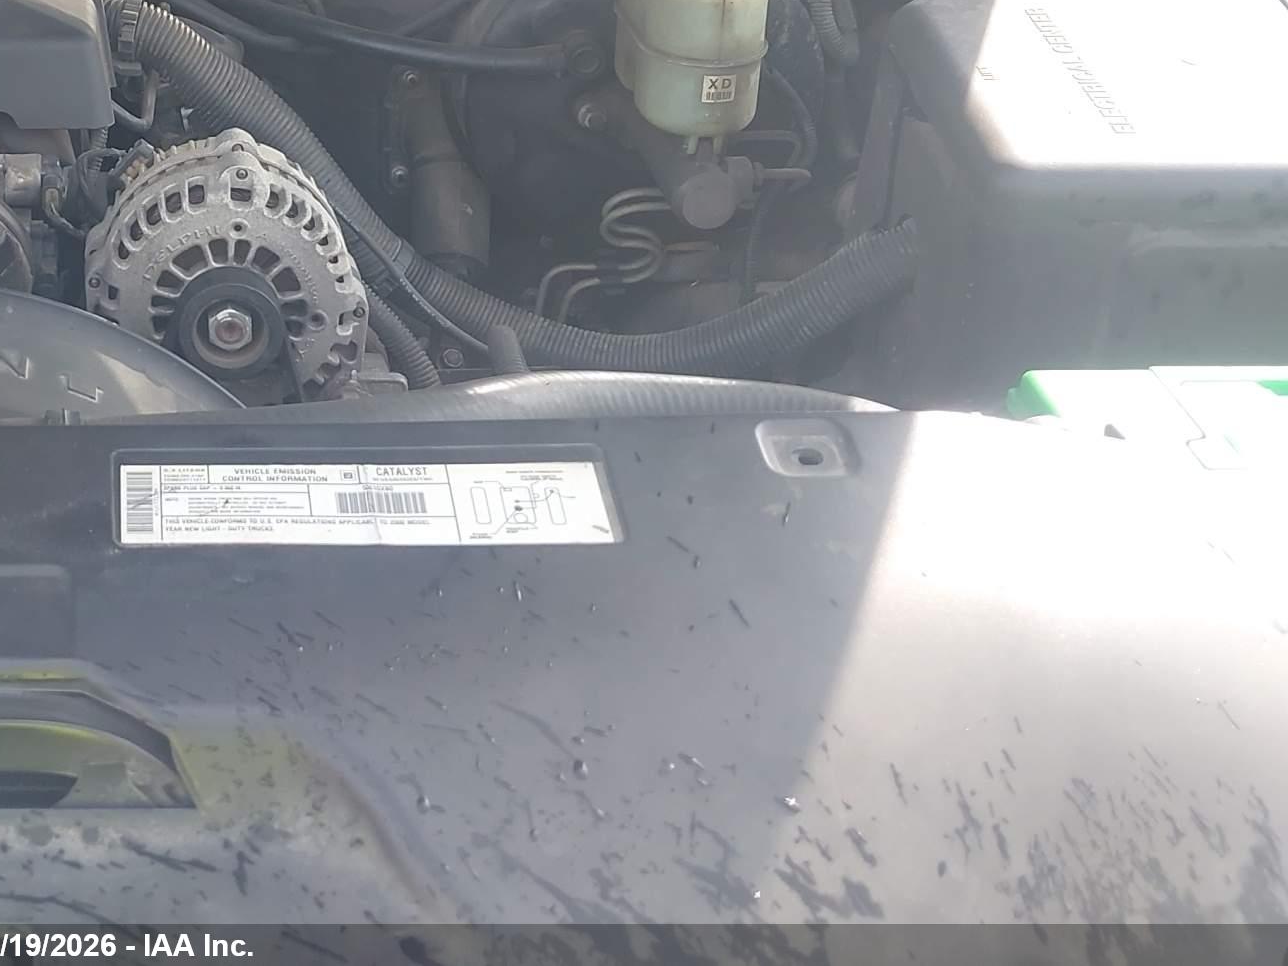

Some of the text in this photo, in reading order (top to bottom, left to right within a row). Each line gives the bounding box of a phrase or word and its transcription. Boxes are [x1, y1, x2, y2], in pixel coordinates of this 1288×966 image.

[1061, 56, 1136, 134] ELECTRICAL
[142, 224, 221, 281] DELPHI
[376, 466, 428, 476] CATALYST
